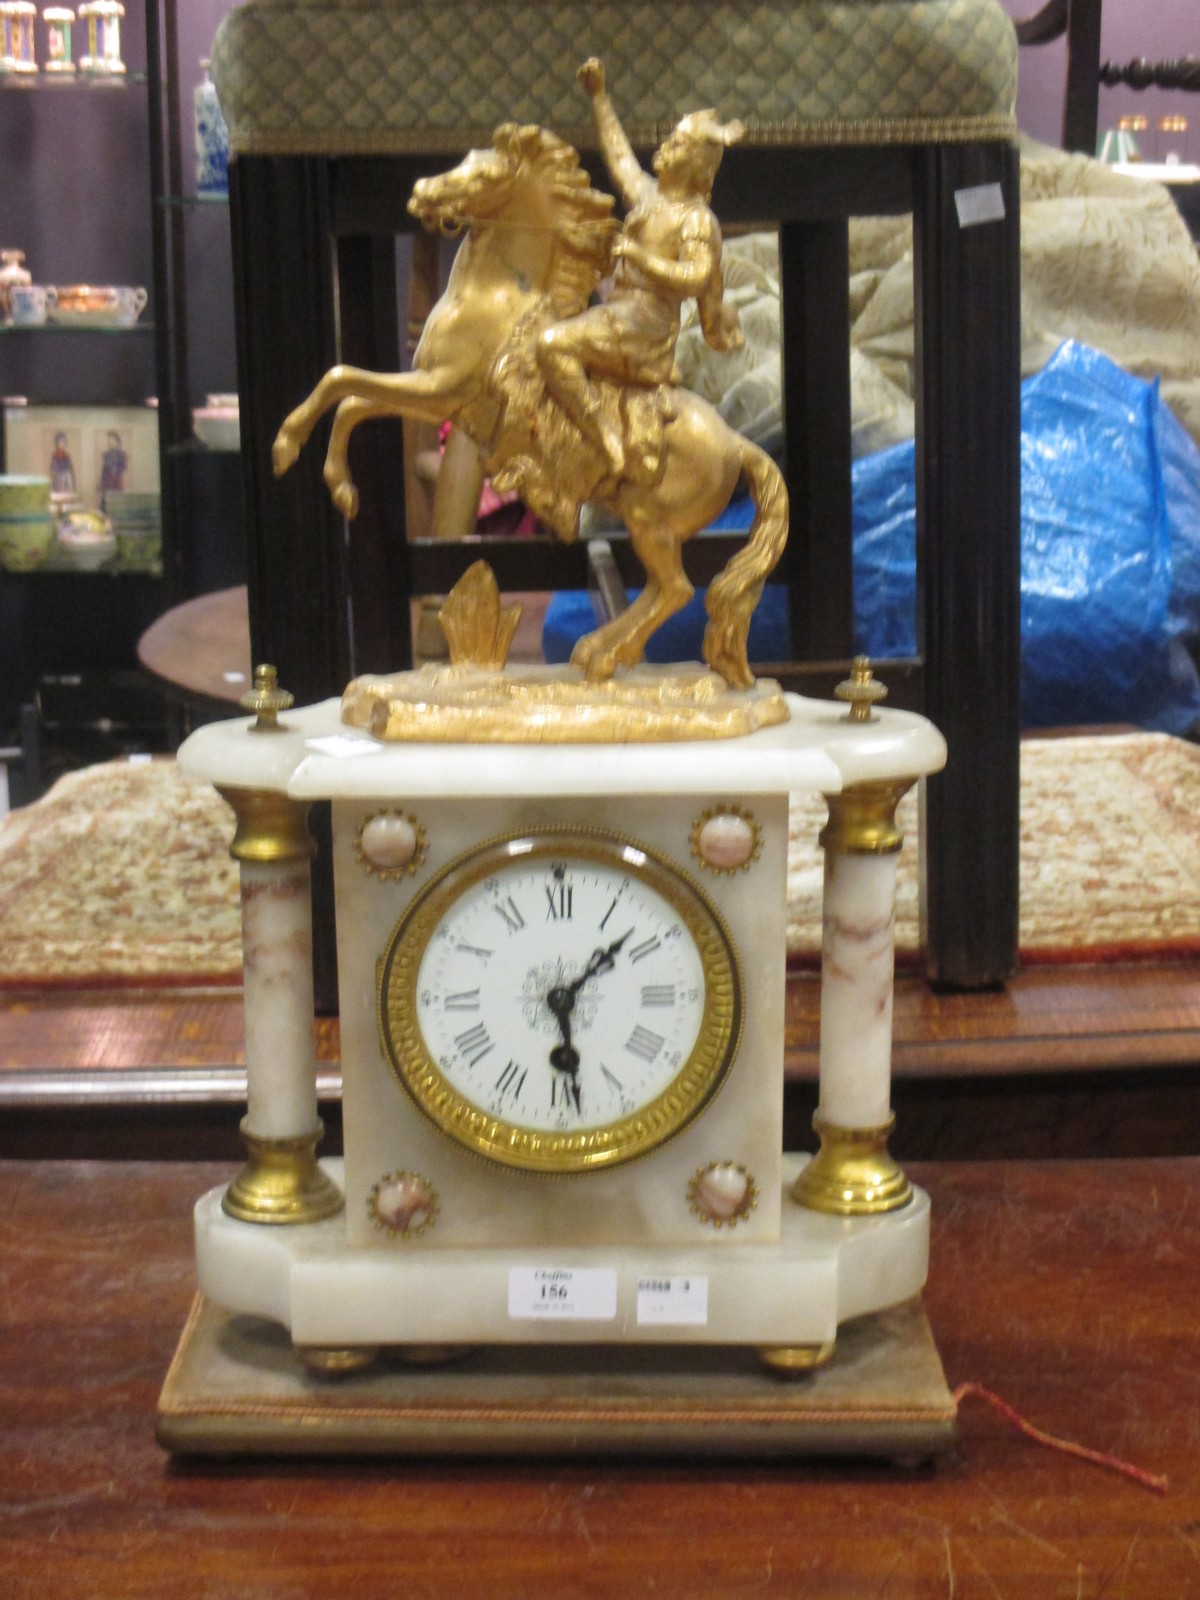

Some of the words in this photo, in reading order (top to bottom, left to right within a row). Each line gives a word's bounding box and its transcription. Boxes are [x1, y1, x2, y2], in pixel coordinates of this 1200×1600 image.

[546, 884, 573, 921] XII
[629, 933, 661, 965] II
[640, 984, 676, 1008] III
[540, 1283, 568, 1300] 156
